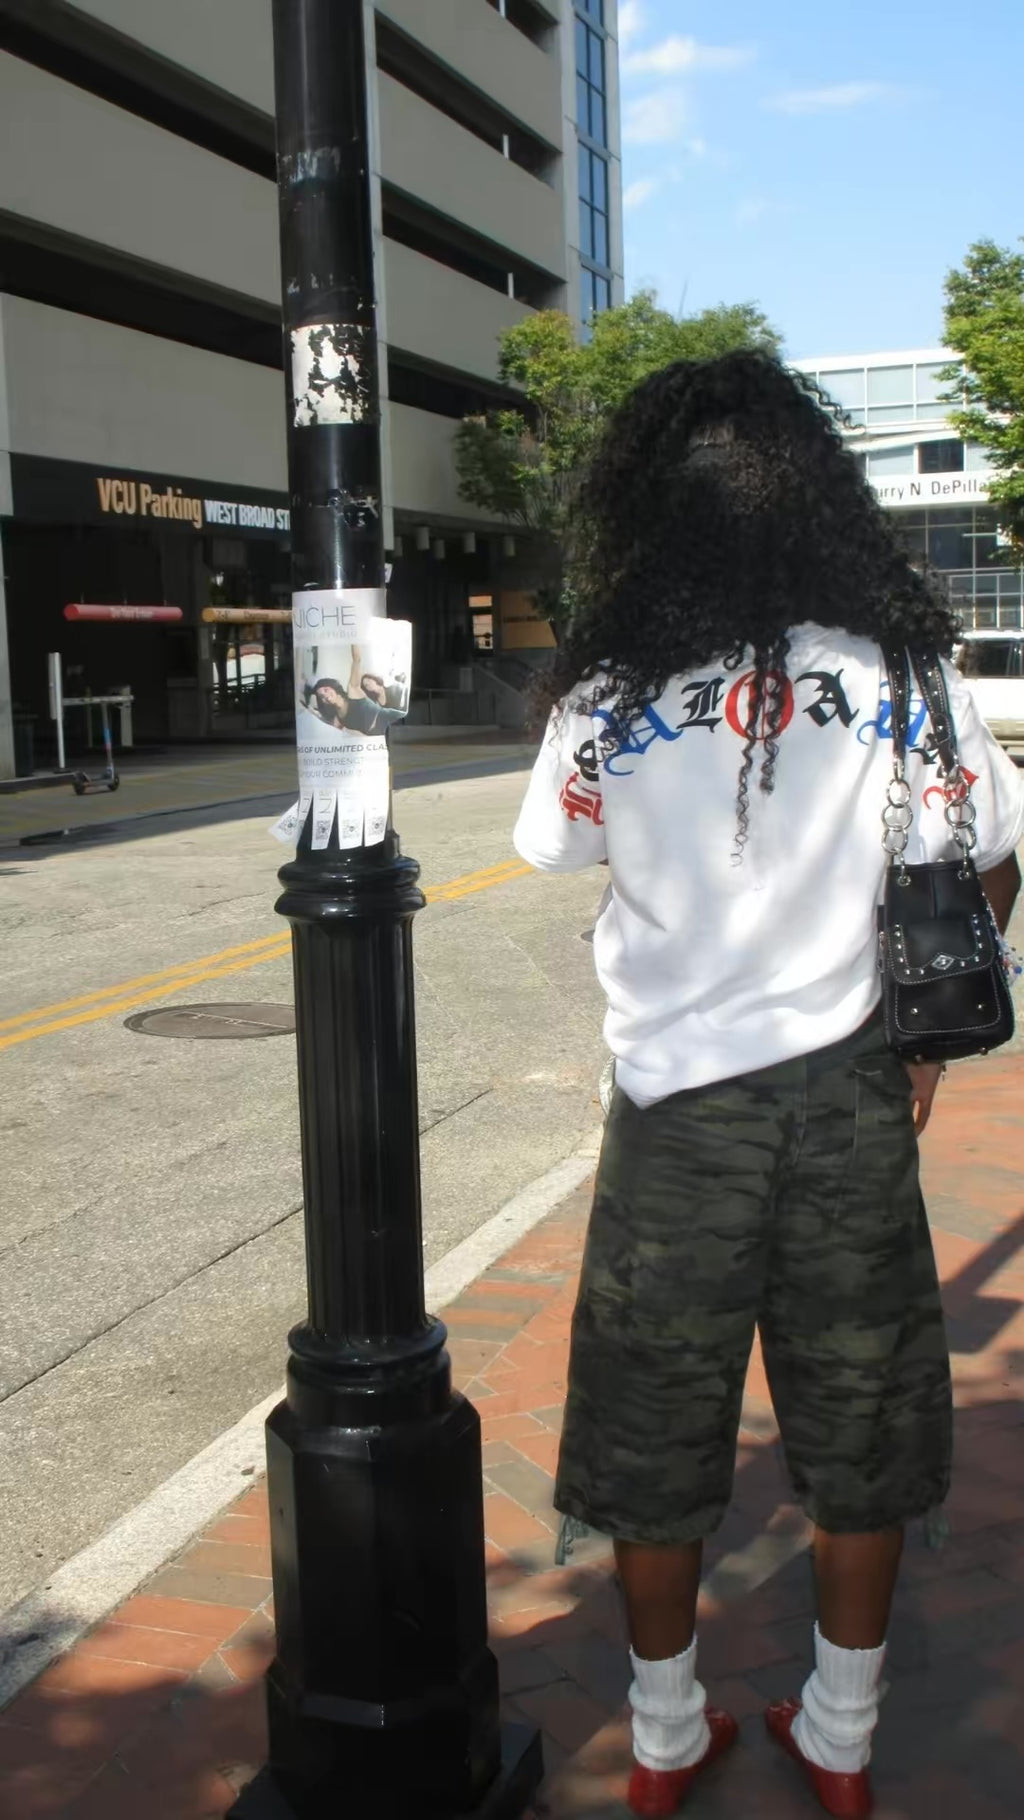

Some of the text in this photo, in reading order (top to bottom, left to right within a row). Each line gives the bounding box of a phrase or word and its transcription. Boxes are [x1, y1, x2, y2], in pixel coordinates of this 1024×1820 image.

[910, 482, 921, 496] N
[97, 478, 136, 515] VCU
[139, 483, 202, 529] Parking
[204, 499, 238, 525] WEST
[239, 504, 275, 529] BROAD
[314, 744, 364, 754] UNLIMITED
